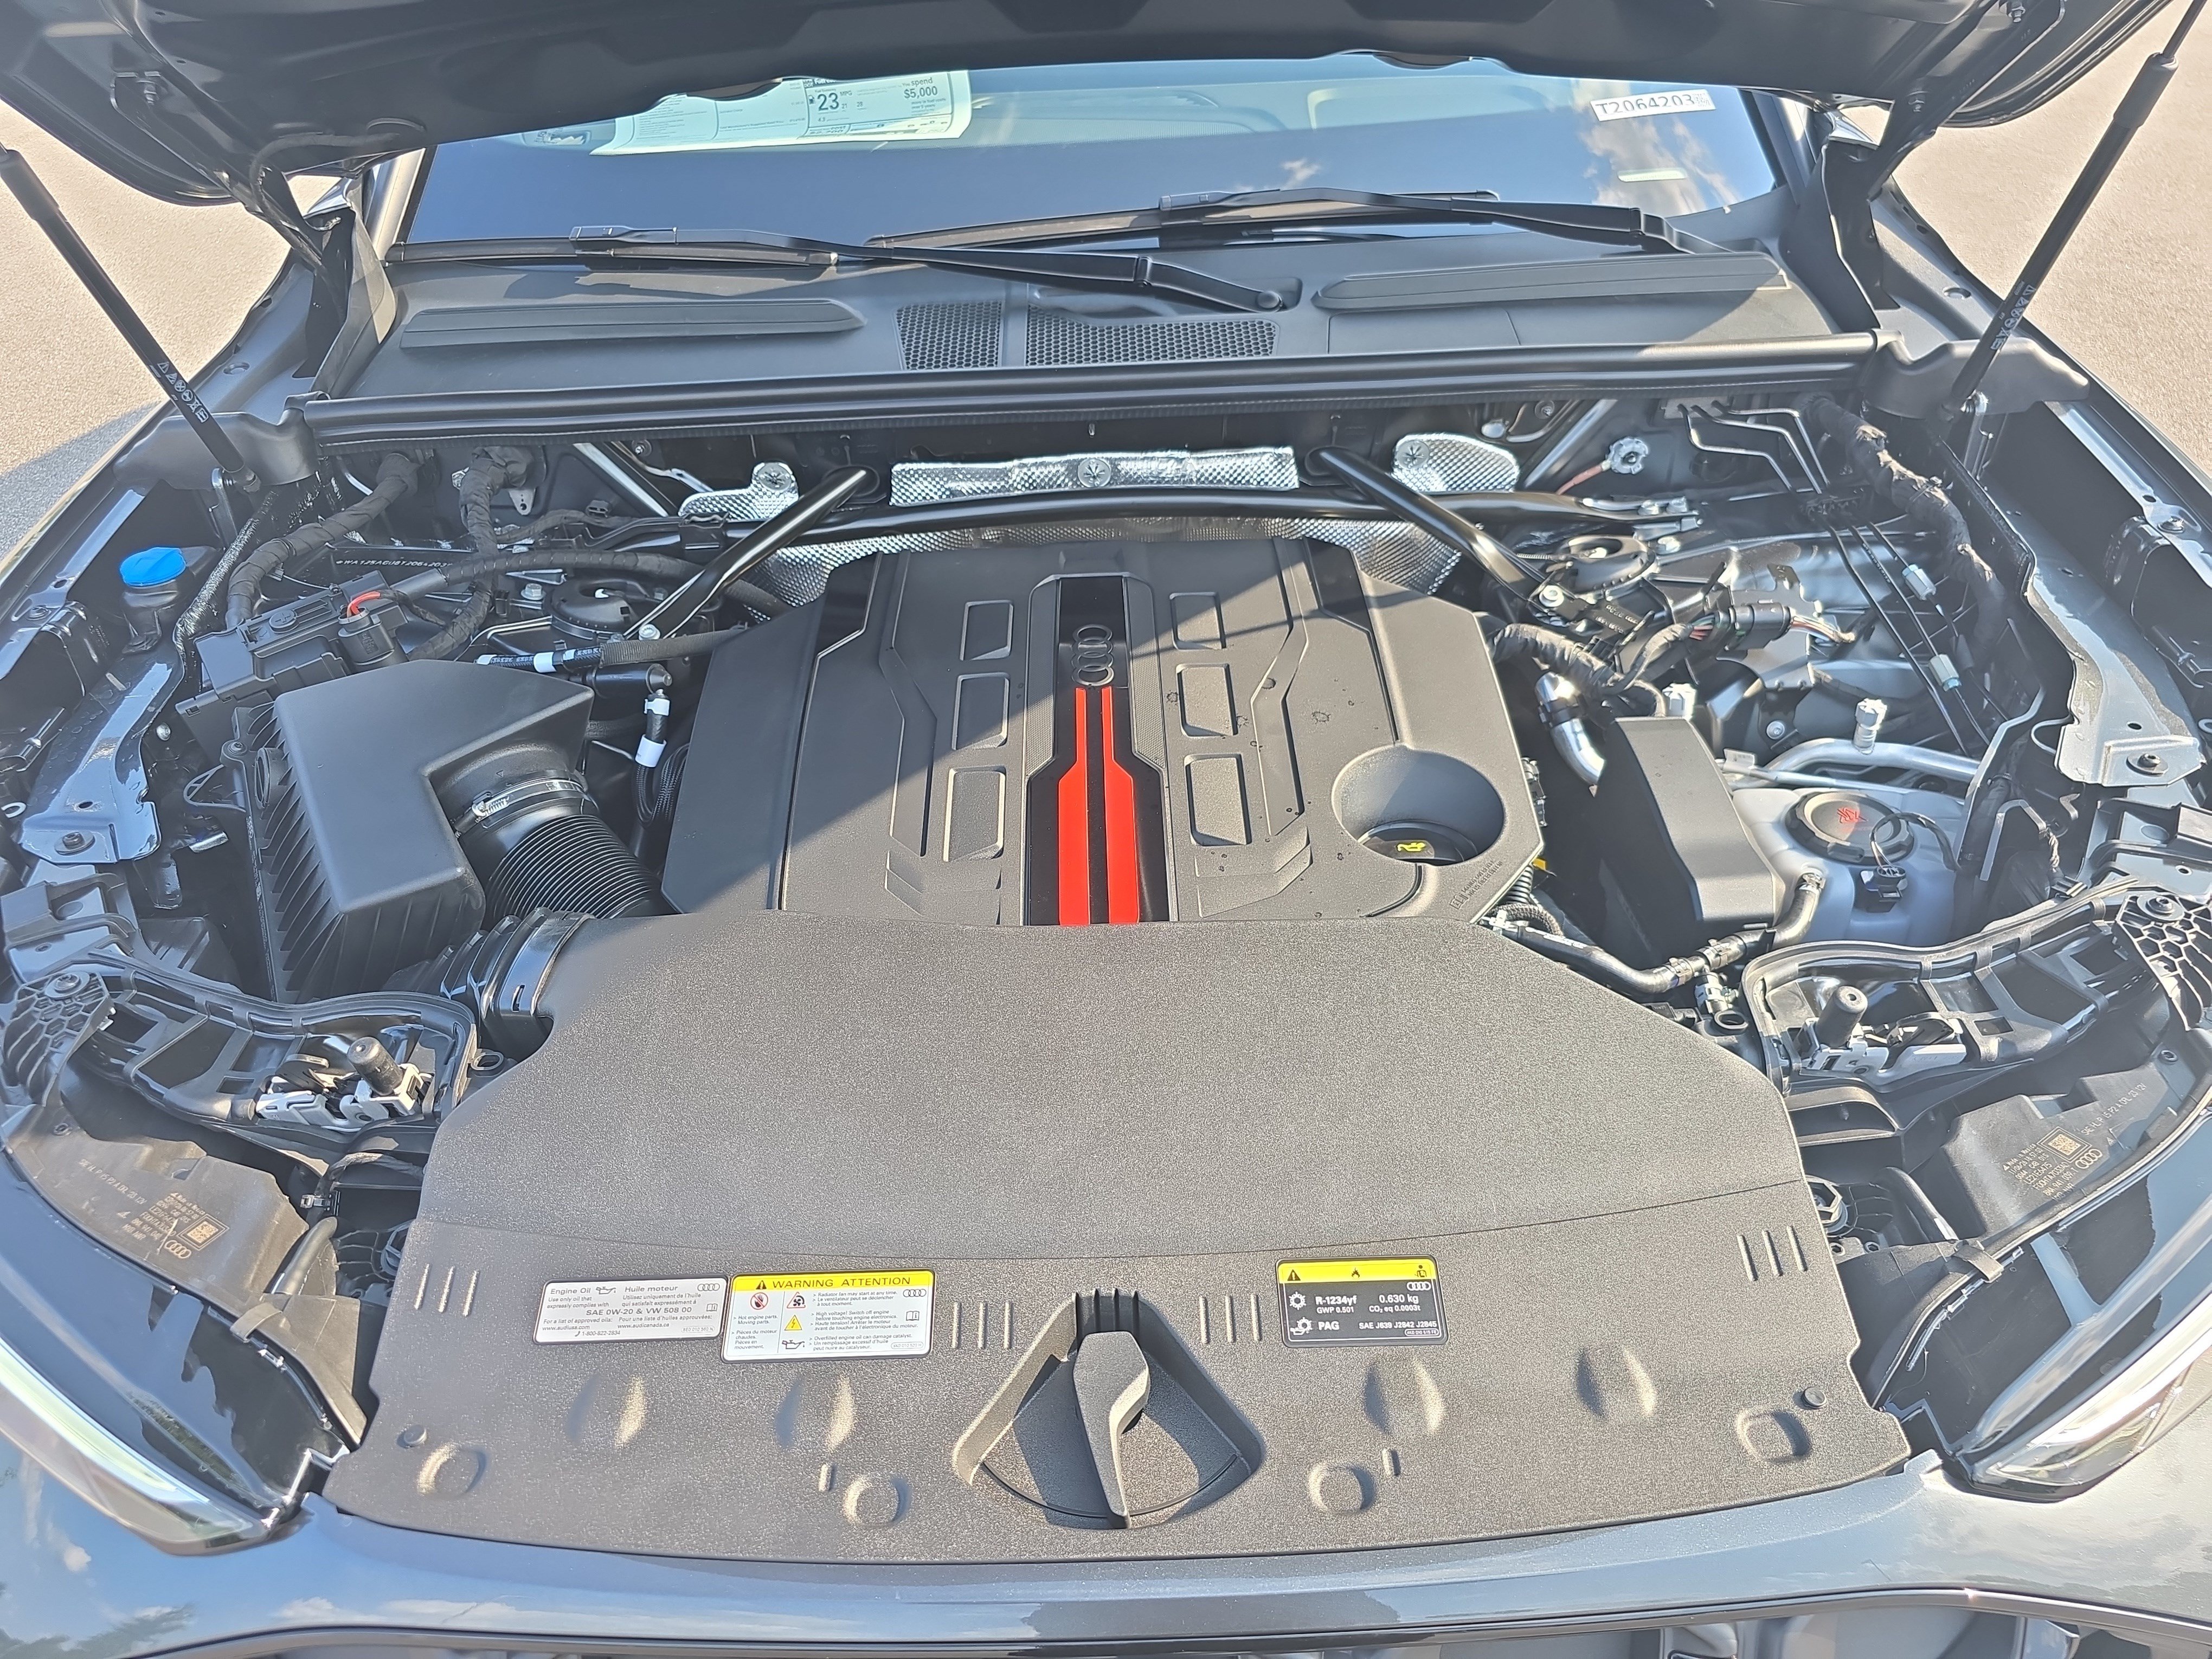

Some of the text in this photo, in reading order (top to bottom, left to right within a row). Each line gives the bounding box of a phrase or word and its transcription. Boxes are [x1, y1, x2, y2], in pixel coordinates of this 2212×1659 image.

[911, 77, 933, 87] spend
[904, 86, 938, 99] $5,000
[817, 92, 839, 112] 23
[1595, 94, 1695, 115] T2064203
[773, 1277, 911, 1288] WARNING ATTENTION
[1315, 1294, 1419, 1306] R-1234yf 0.630 kg
[1318, 1321, 1340, 1330] PAG
